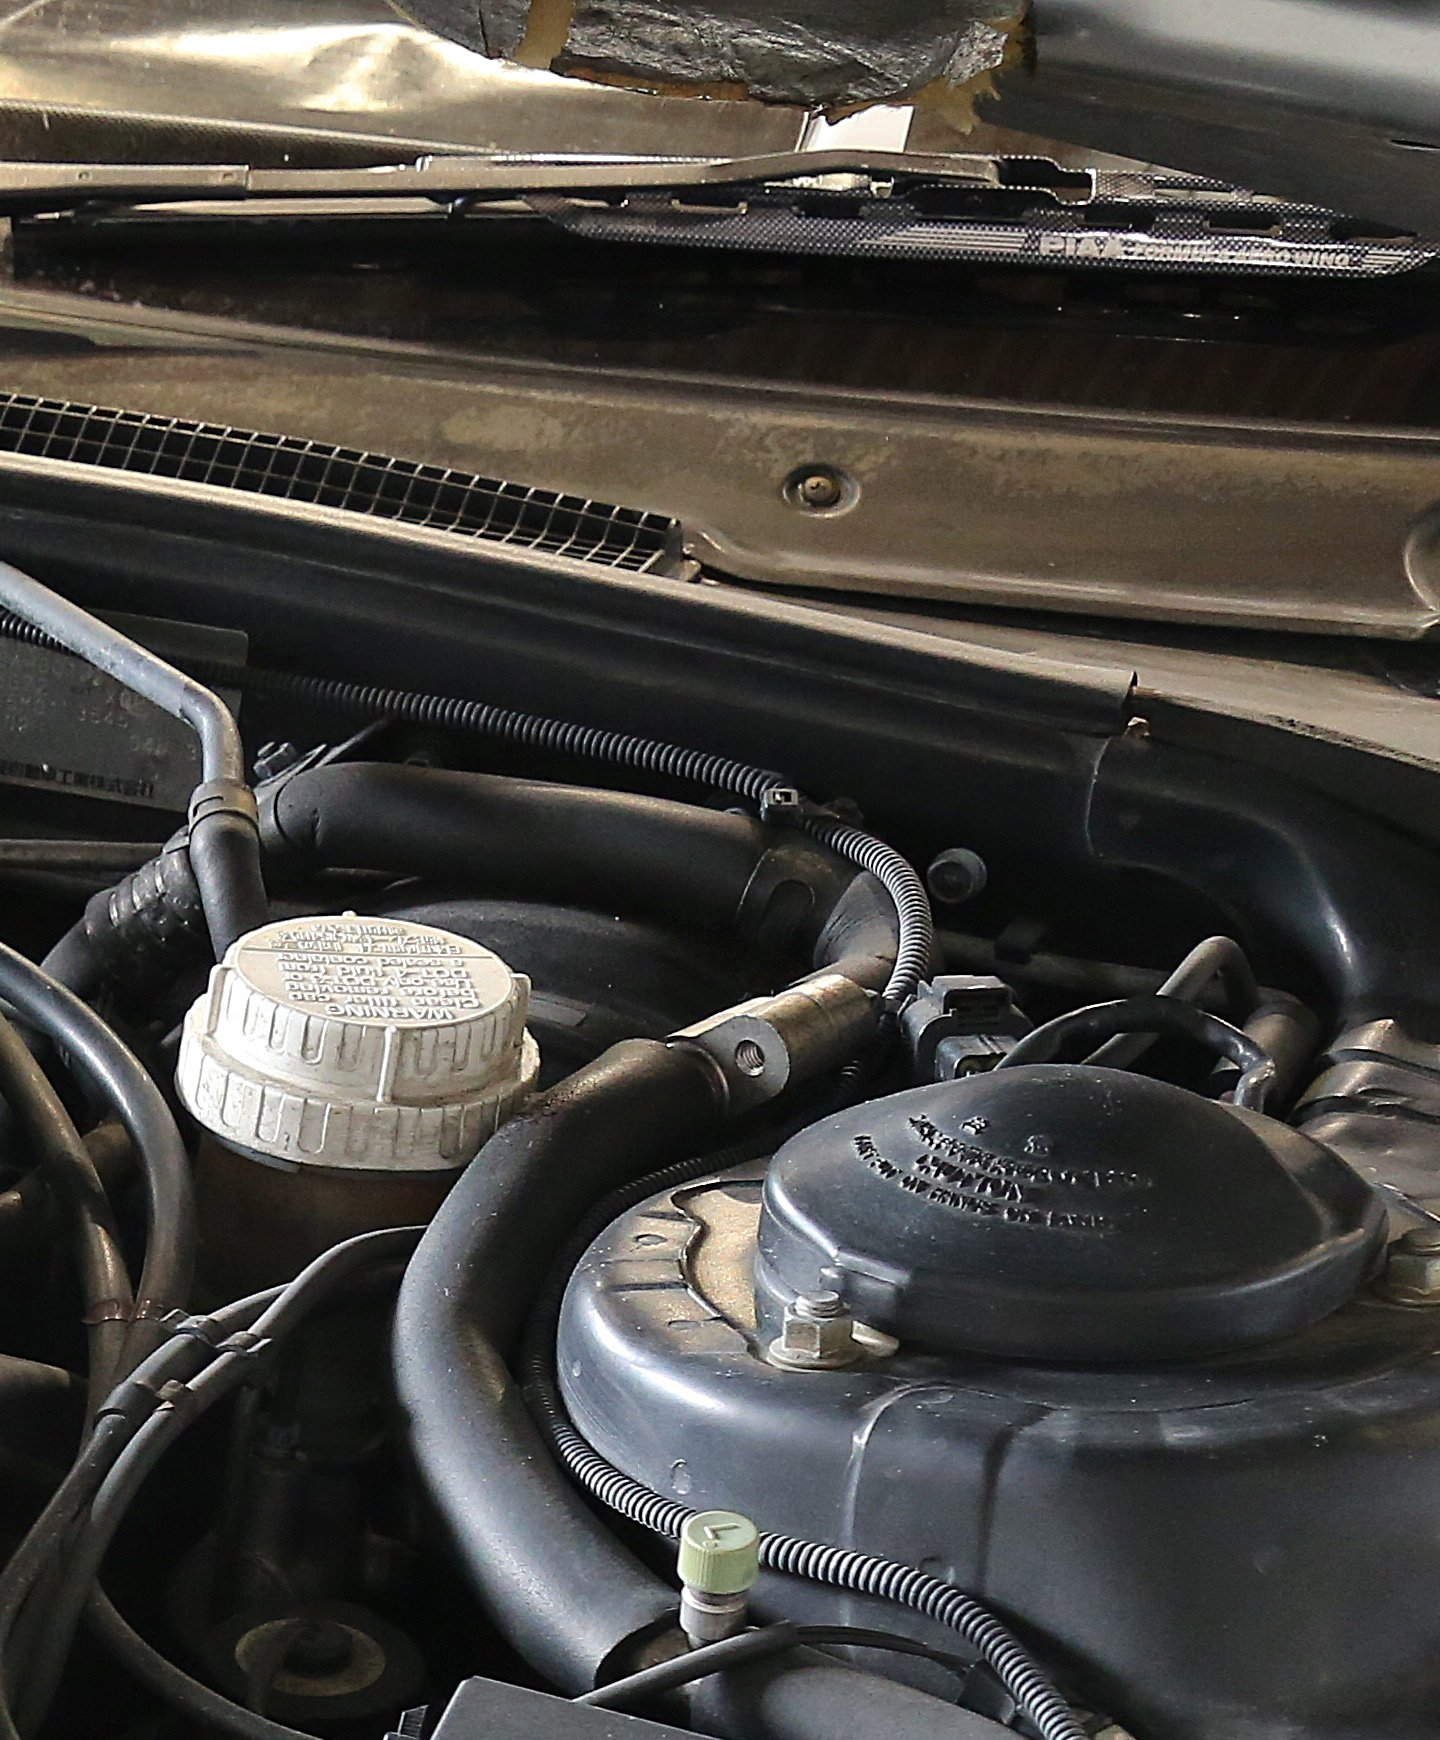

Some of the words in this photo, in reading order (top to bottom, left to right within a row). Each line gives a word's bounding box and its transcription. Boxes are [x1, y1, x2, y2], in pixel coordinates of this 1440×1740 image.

[1040, 236, 1125, 258] PIAA
[1289, 251, 1350, 266] WING
[276, 952, 368, 965] container
[285, 981, 389, 995] removing
[324, 1004, 453, 1019] WARNING
